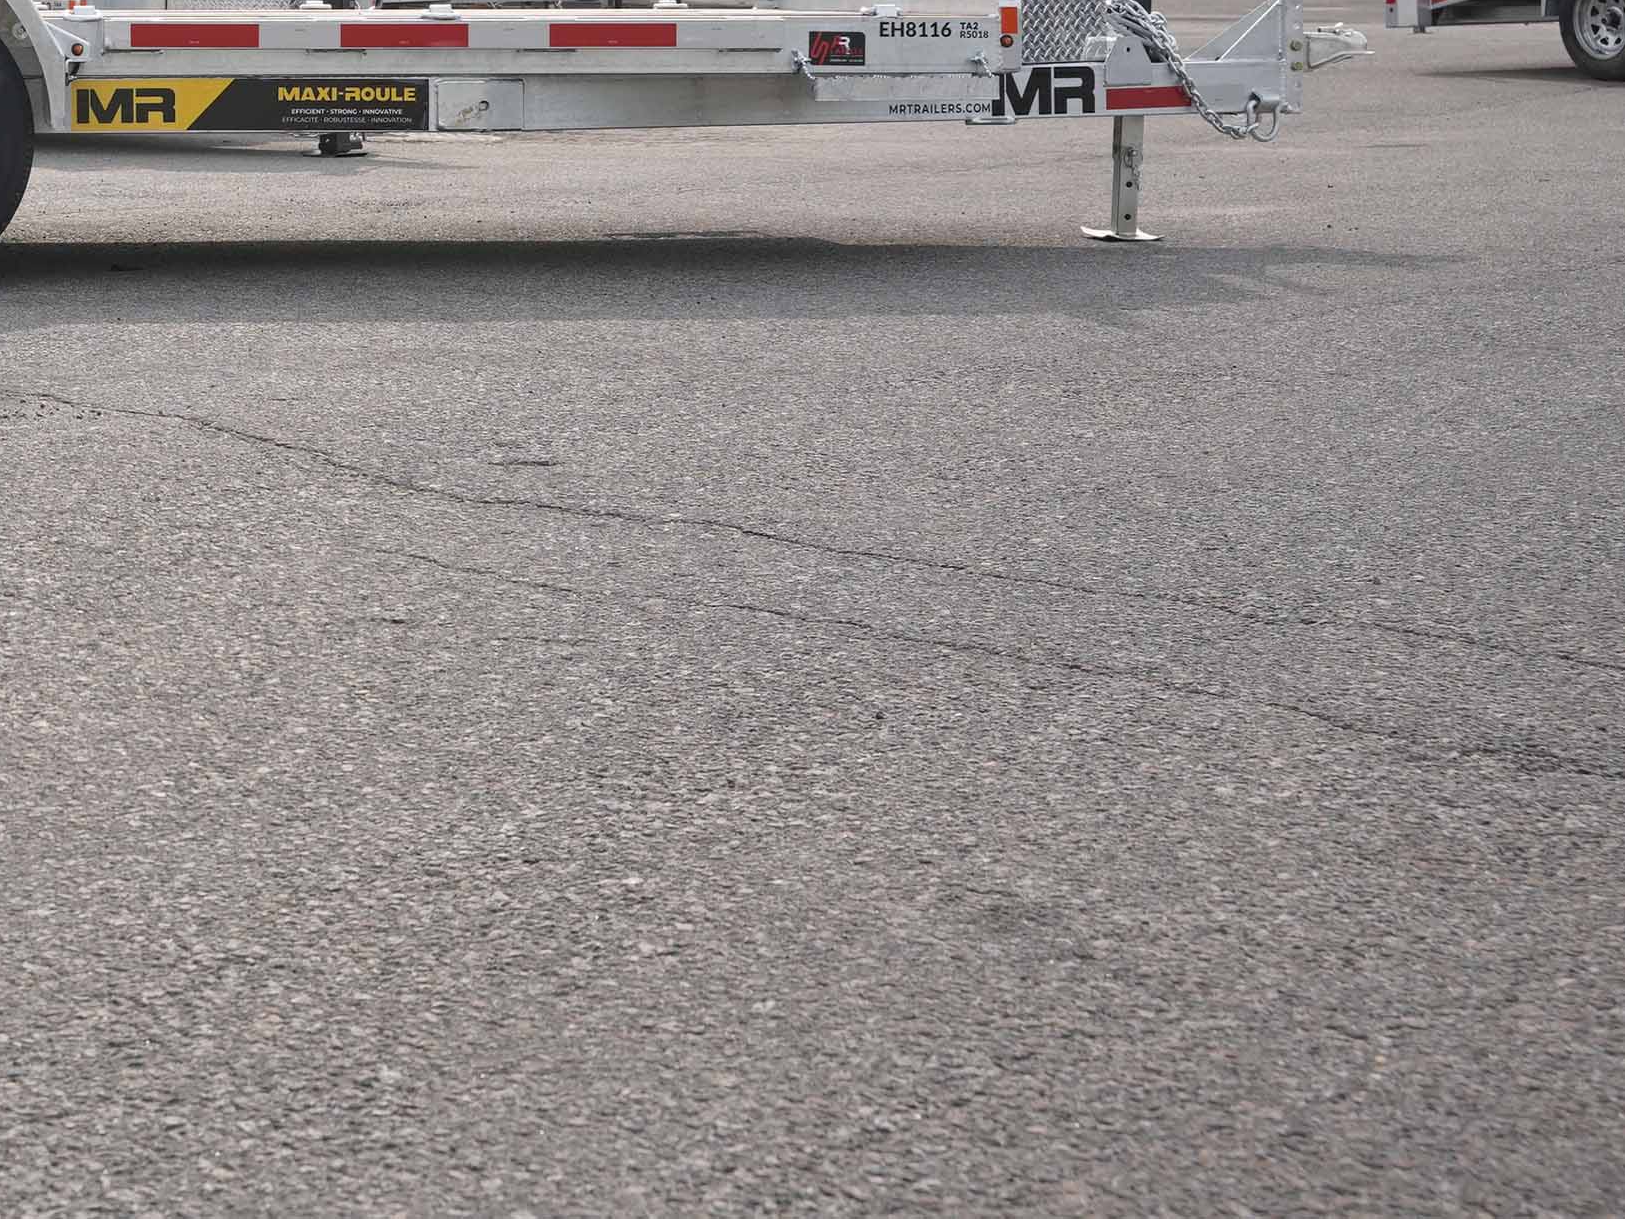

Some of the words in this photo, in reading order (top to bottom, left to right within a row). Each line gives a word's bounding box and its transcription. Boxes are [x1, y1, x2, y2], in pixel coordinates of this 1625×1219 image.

[879, 21, 952, 38] EH8116
[959, 21, 978, 30] TA2
[959, 30, 989, 39] R5018
[278, 87, 416, 101] MAXI-ROULE
[991, 66, 1096, 116] MR
[76, 88, 176, 124] MR
[888, 103, 991, 116] MRTRAILERS.COM
